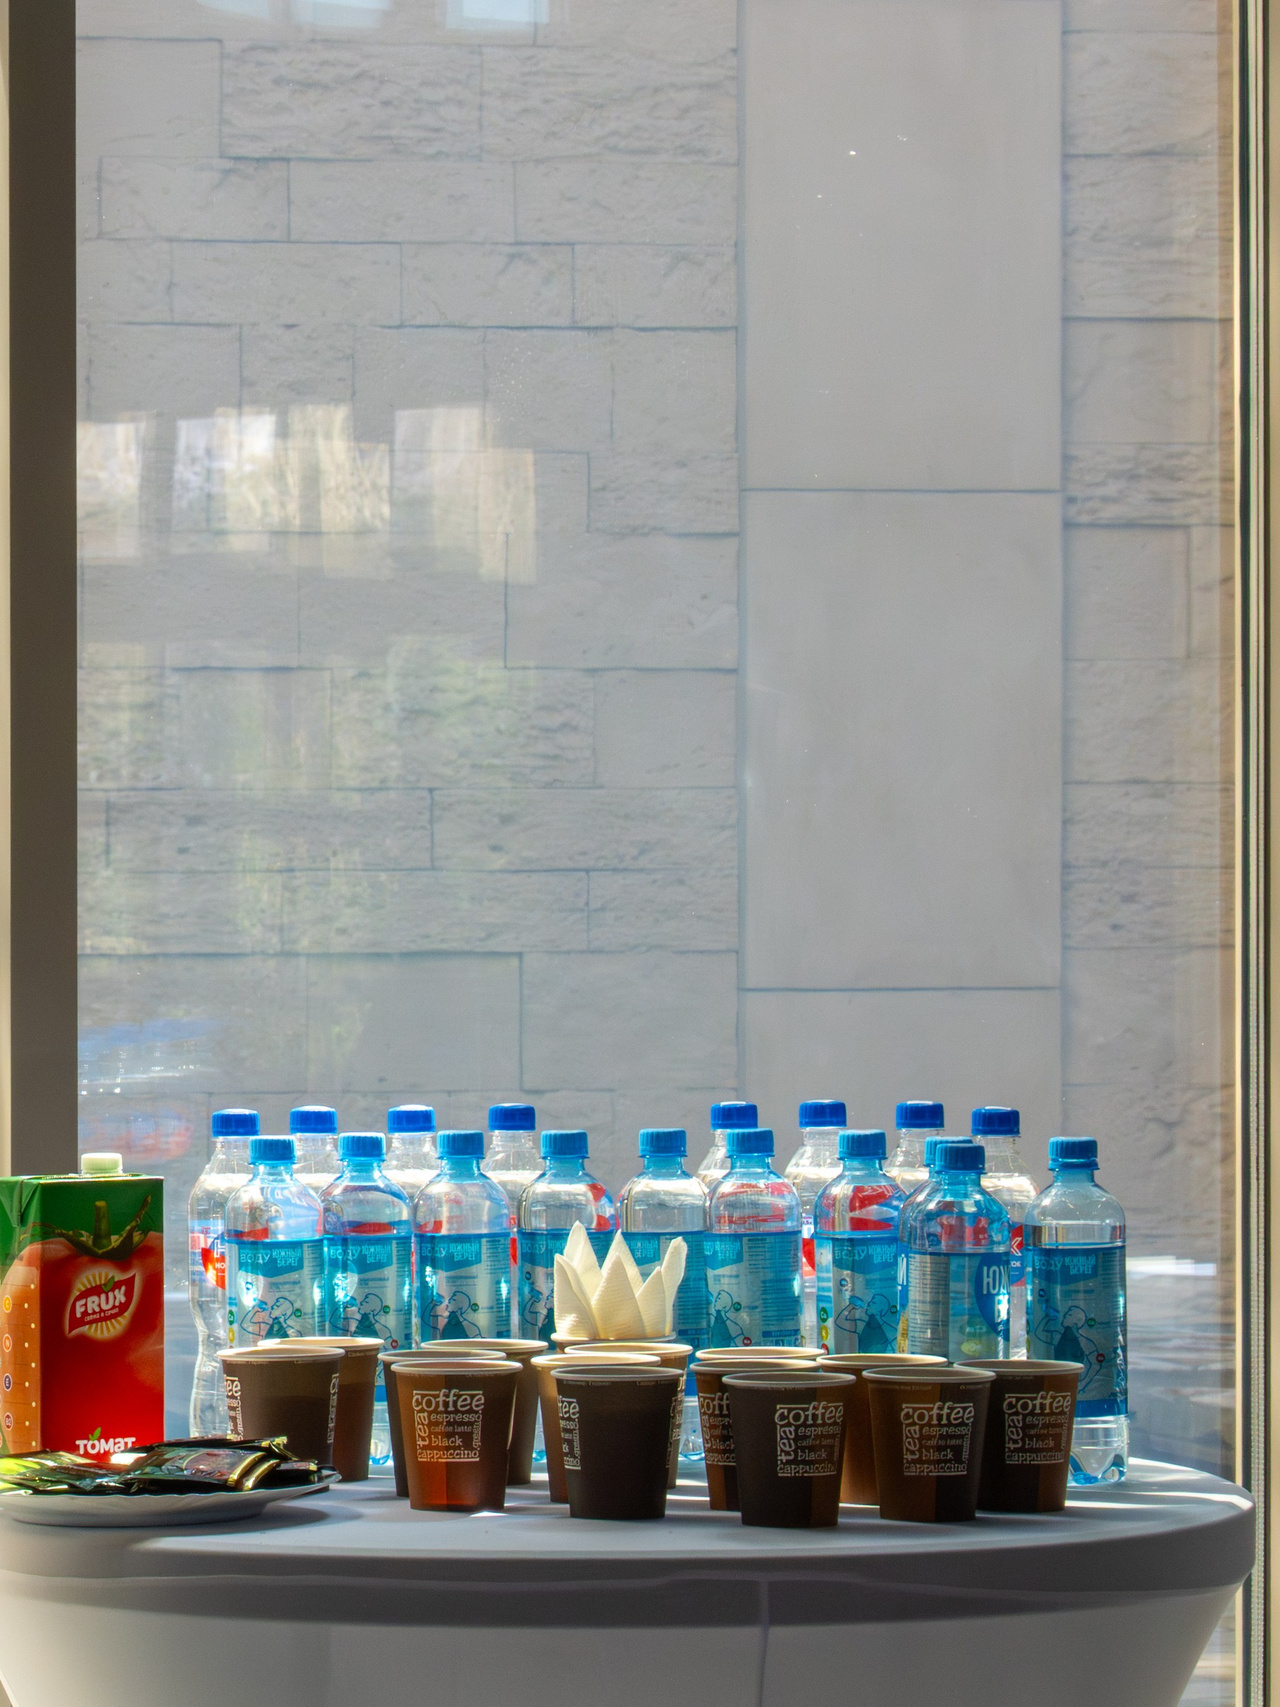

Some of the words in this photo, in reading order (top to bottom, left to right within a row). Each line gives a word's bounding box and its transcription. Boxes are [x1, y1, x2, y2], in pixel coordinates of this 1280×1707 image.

[75, 1285, 127, 1318] FRUX
[412, 1388, 485, 1411] coffee
[699, 1392, 730, 1414] coff
[1003, 1391, 1072, 1414] coffee
[430, 1413, 483, 1425] espresso
[775, 1401, 844, 1425] coffee
[901, 1402, 975, 1424] coffee
[416, 1412, 429, 1448] tea
[431, 1434, 463, 1446] black
[1005, 1414, 1023, 1450] tea
[417, 1447, 479, 1461] cappuccino
[778, 1425, 795, 1462] tea
[798, 1448, 827, 1460] black
[903, 1425, 920, 1461] tea
[922, 1448, 954, 1460] black
[1025, 1437, 1055, 1449] black
[903, 1460, 967, 1475] cappuccino
